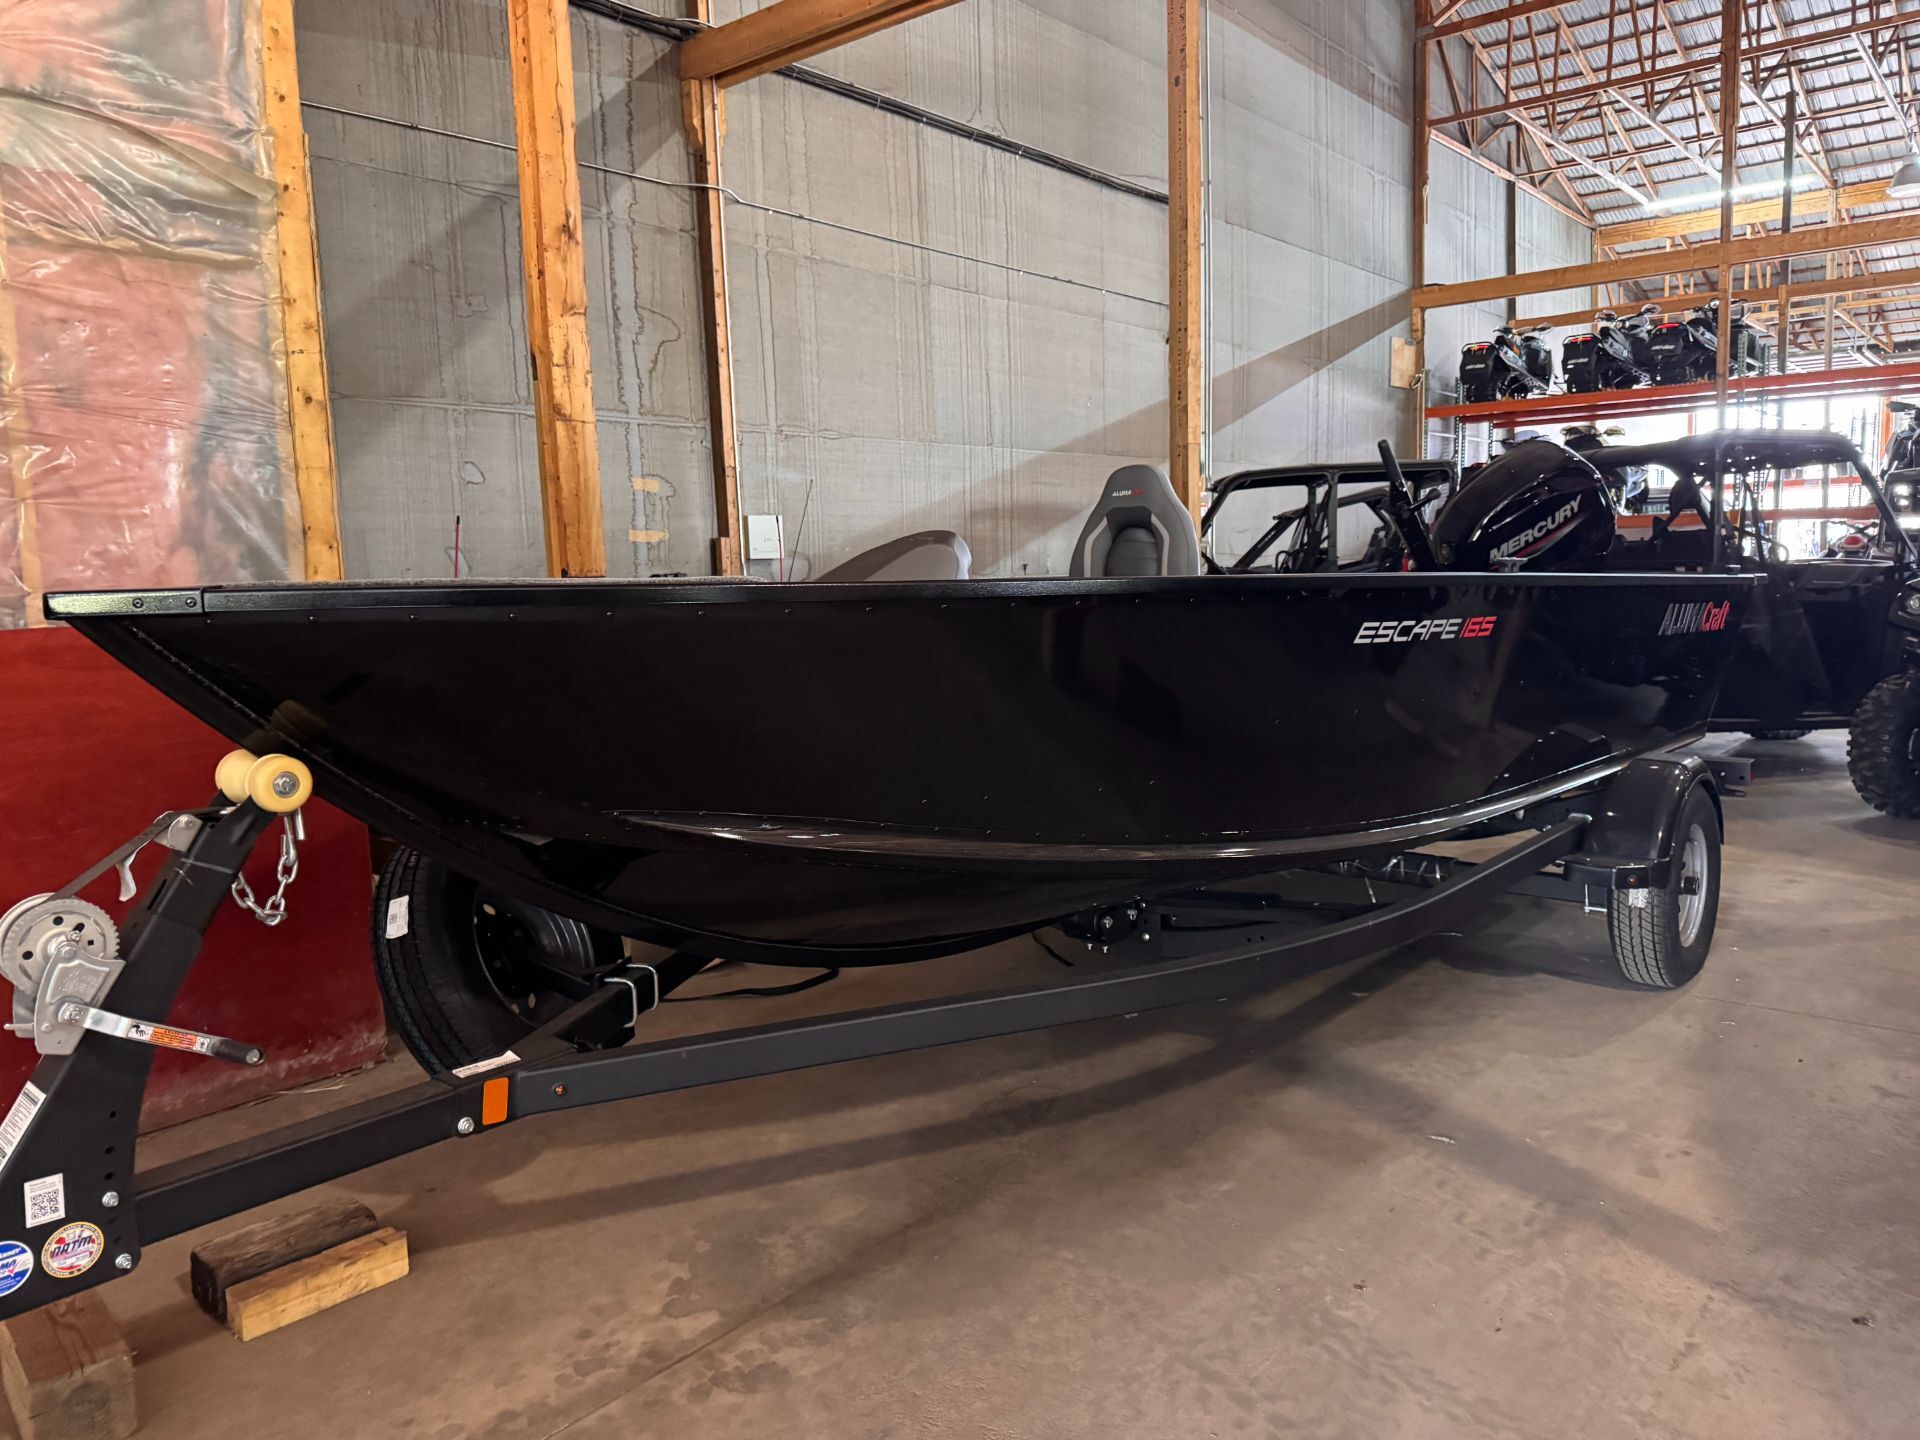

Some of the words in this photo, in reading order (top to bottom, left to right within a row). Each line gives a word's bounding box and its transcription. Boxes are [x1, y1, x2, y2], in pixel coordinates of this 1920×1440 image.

[1489, 494, 1582, 564] MERCURY
[1353, 618, 1463, 644] ESCAPE
[1460, 616, 1498, 638] 165
